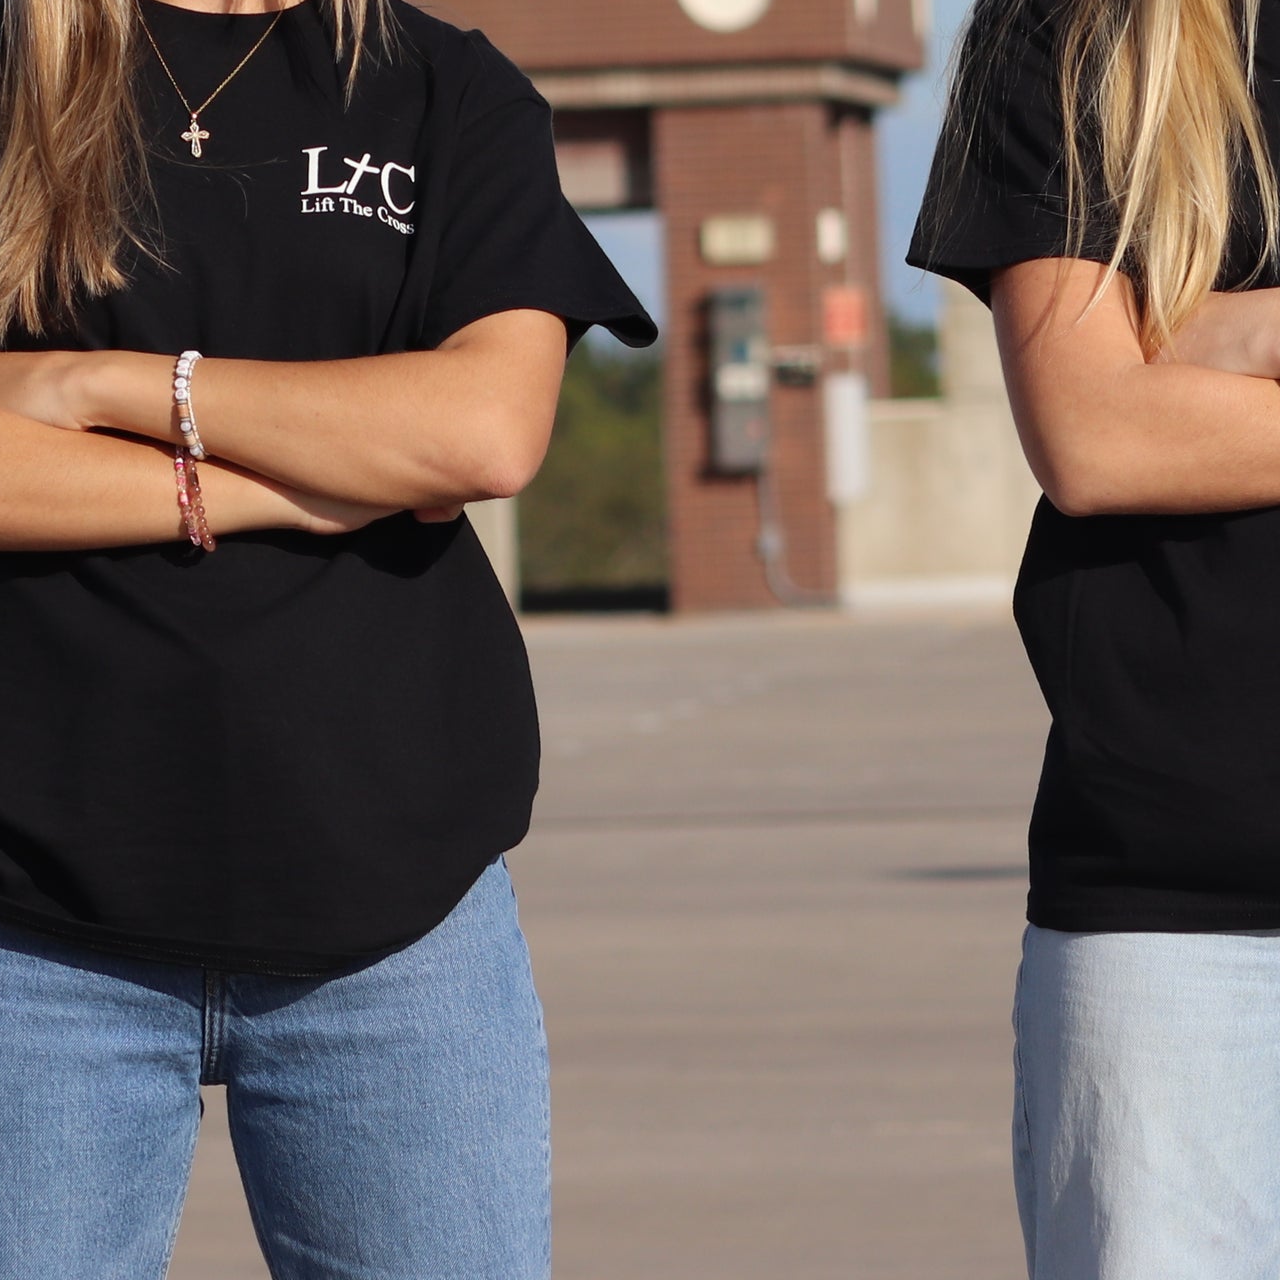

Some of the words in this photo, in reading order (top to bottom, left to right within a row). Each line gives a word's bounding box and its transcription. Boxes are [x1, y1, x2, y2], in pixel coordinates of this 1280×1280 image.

[300, 197, 335, 213] Lift
[339, 197, 373, 217] The
[377, 206, 415, 235] Cross
